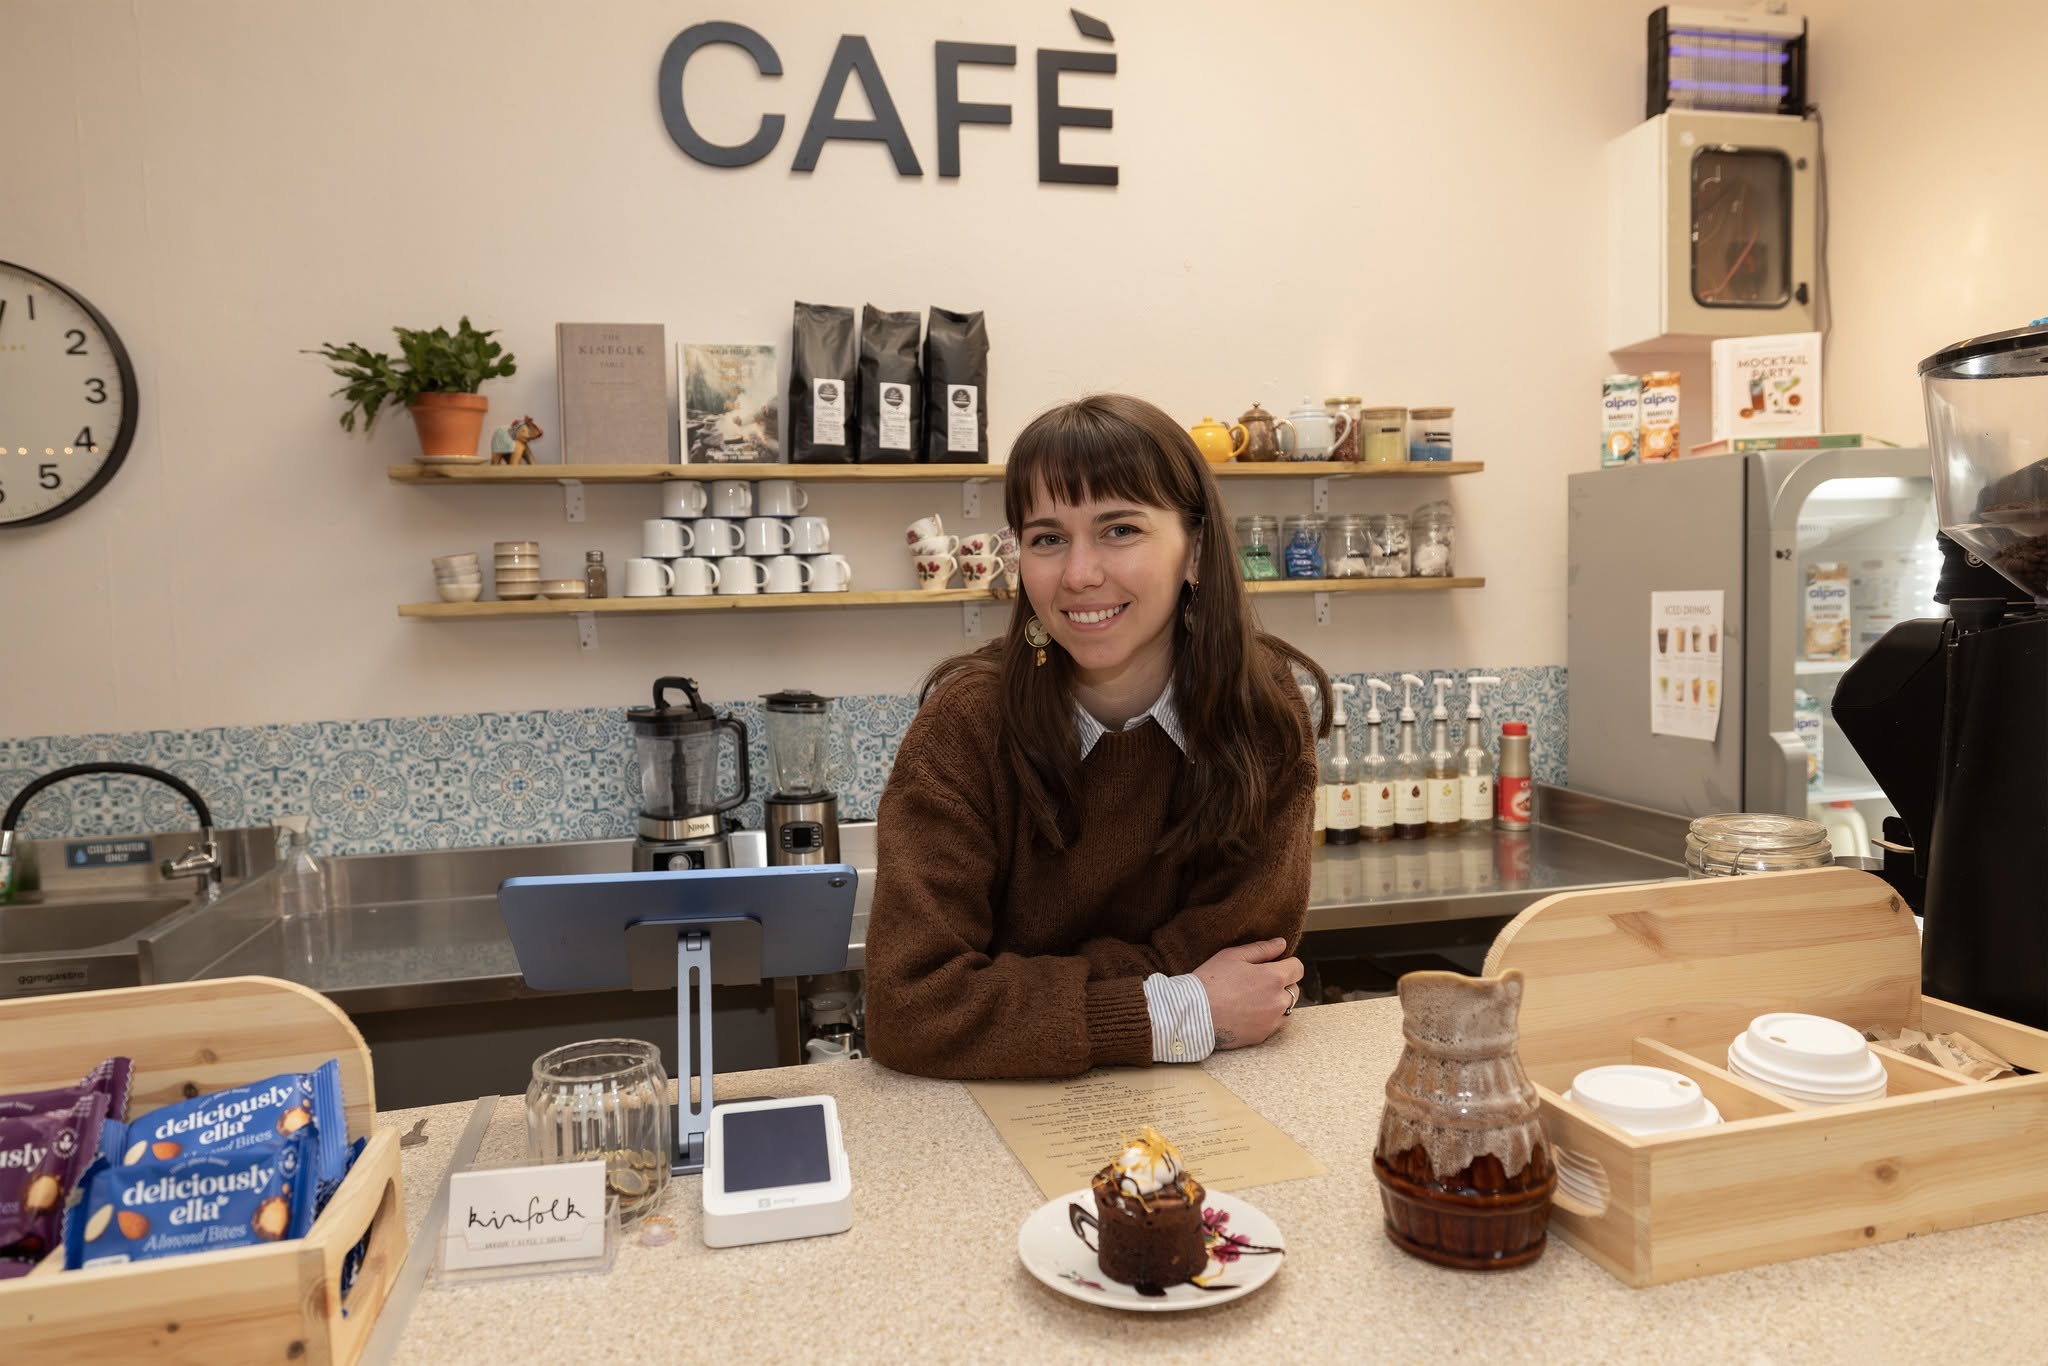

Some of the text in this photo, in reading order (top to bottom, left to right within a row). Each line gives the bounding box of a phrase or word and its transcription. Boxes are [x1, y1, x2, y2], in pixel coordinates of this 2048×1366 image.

[659, 8, 1118, 186] CAFÈ
[27, 294, 35, 321] 1
[65, 329, 88, 355] 2
[578, 345, 646, 356] KINFOLK
[1737, 355, 1808, 369] MOCKTAIL
[1752, 367, 1795, 379] PARTY
[84, 378, 107, 404] 3
[1644, 392, 1677, 406] alpro
[1605, 396, 1638, 410] alpro
[73, 426, 96, 452] 4
[1776, 438, 1819, 450] LEON
[39, 464, 61, 490] 5
[1808, 587, 1846, 600] alpro
[1665, 605, 1712, 616] ICED DRINKS
[105, 853, 129, 863] ONLY
[114, 842, 147, 852] WATER
[18, 970, 86, 985] ggmgastro
[155, 1084, 294, 1140] deliciously
[199, 1120, 245, 1145] ella
[236, 1130, 272, 1149] Bites
[122, 1164, 275, 1205] deliciously
[169, 1198, 220, 1226] ella
[468, 1196, 586, 1231] kinfolk
[144, 1224, 248, 1251] Almond Bites
